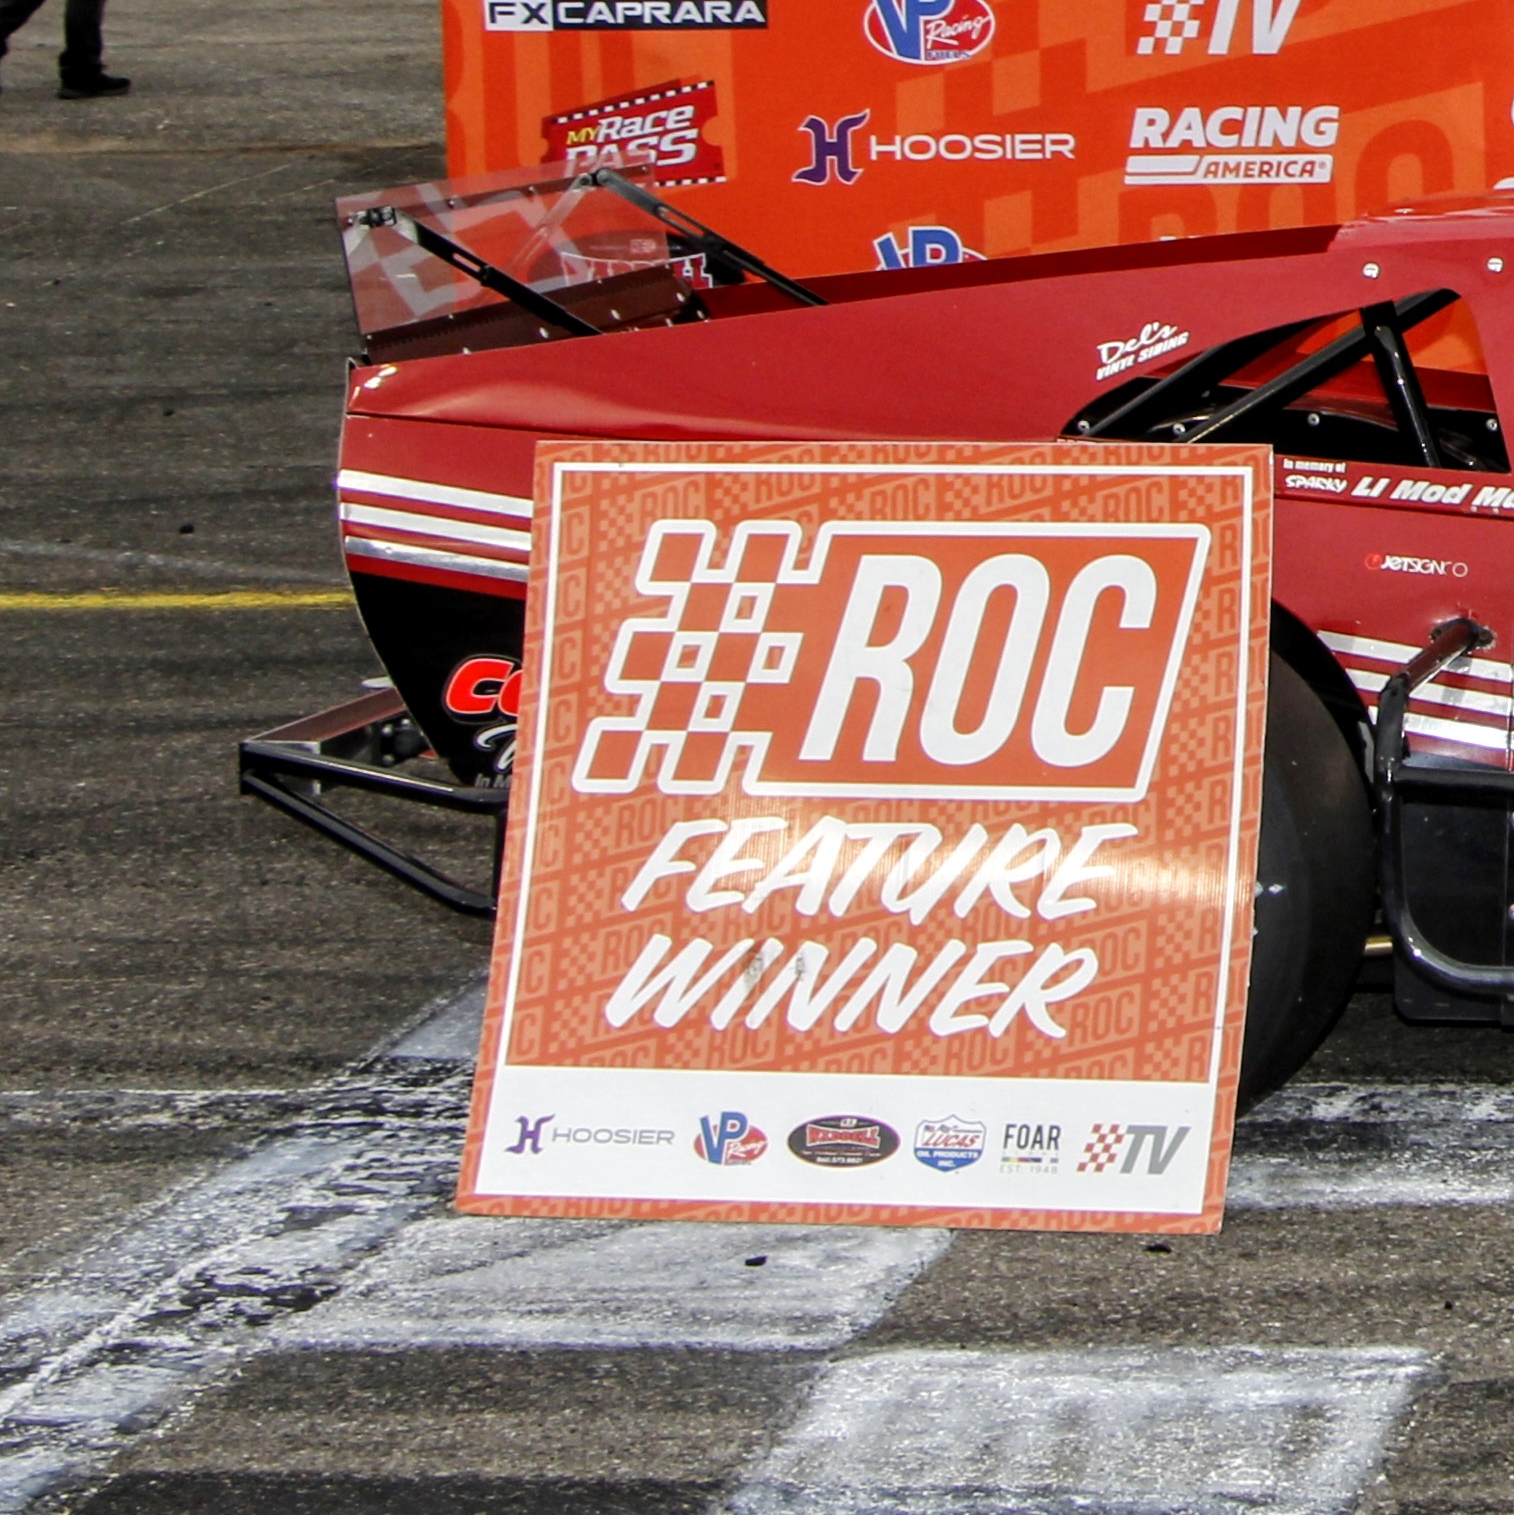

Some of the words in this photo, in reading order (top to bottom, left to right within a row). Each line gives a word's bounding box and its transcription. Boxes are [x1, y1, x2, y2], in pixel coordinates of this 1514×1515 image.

[489, 1, 551, 26] FX
[557, 0, 765, 24] CAPRARA
[925, 12, 992, 47] Racing
[1097, 321, 1178, 365] Del's
[1352, 476, 1391, 498] LI
[1391, 479, 1473, 505] Mod
[798, 553, 1157, 768] ROC
[621, 816, 1139, 926] FEATURE
[604, 933, 1099, 1039] WINNER
[552, 1127, 676, 1146] HOOSIER
[700, 1111, 748, 1166] VP
[922, 1135, 980, 1148] LUCAS
[1003, 1124, 1062, 1152] FOAR
